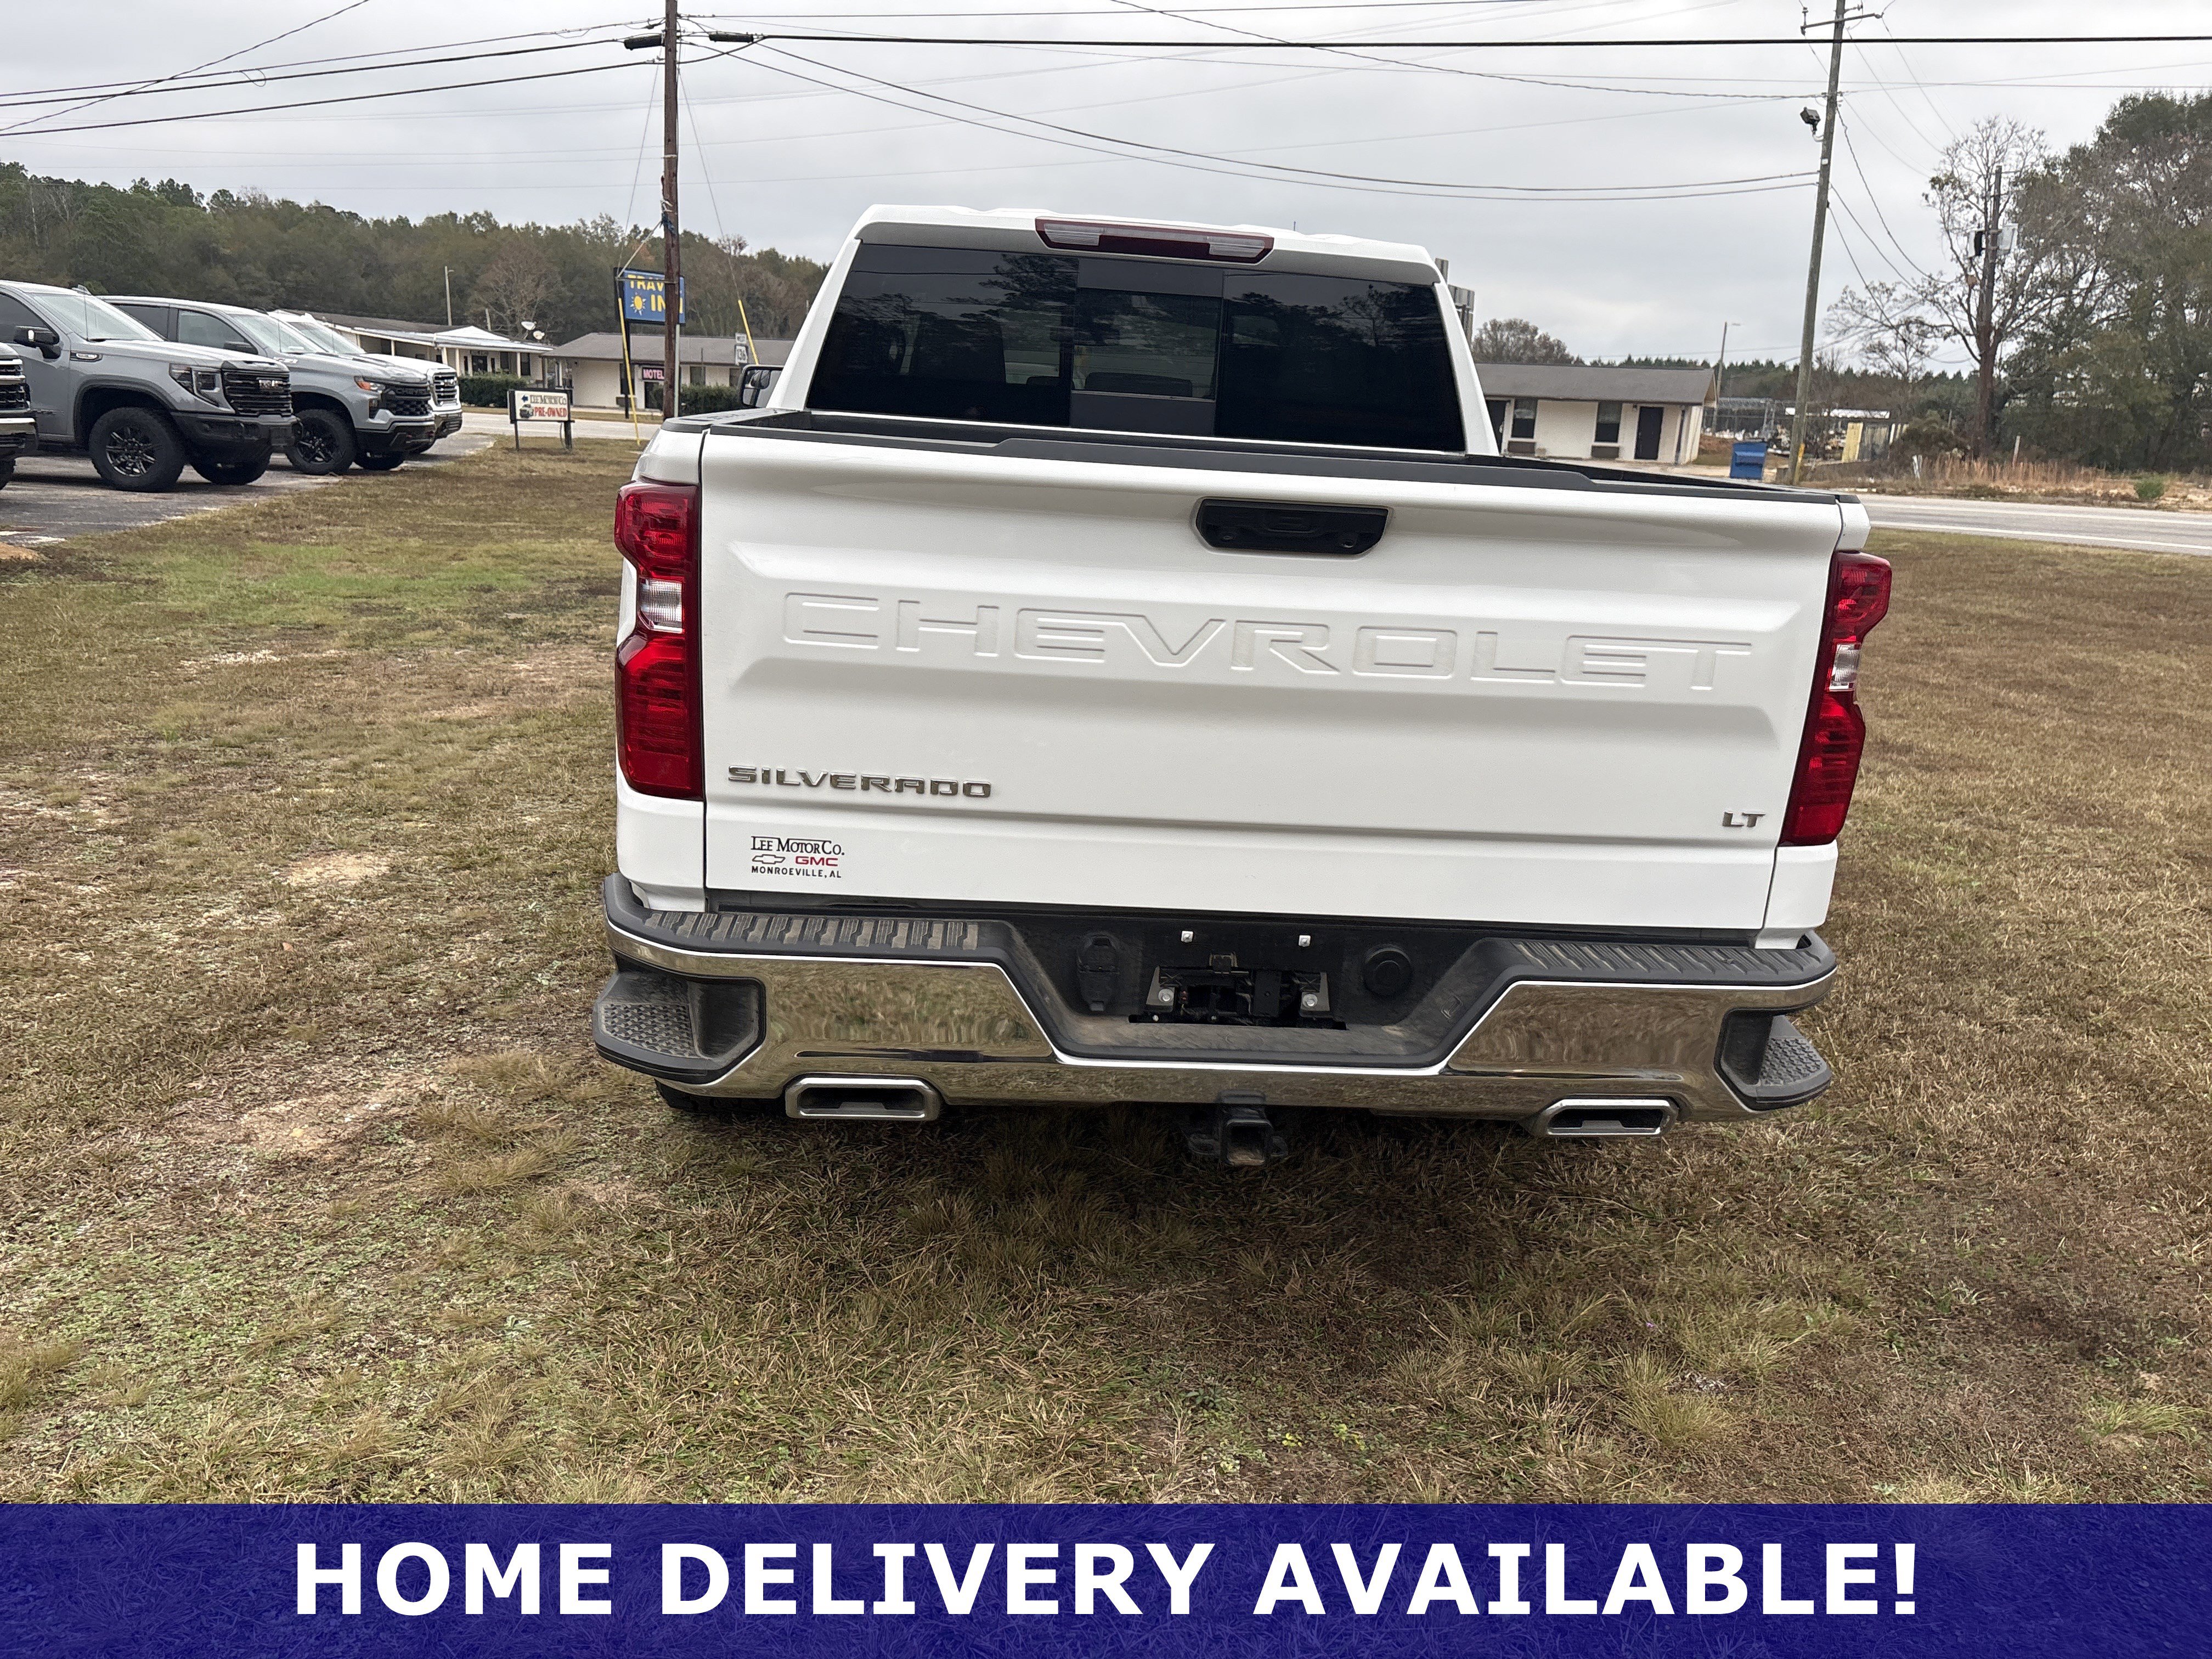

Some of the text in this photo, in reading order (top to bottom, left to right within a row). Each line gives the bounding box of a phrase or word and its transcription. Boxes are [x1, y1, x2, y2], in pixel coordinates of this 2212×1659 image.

[628, 274, 664, 292] TRAV
[643, 369, 665, 379] MOTEL
[534, 407, 567, 417] PRE-OWNED
[783, 592, 1752, 691] CHEVROLET
[728, 765, 991, 798] SILVERADO
[1722, 811, 1766, 827] LT
[795, 856, 839, 867] GMC
[751, 865, 842, 879] MONROEVILLE, AL
